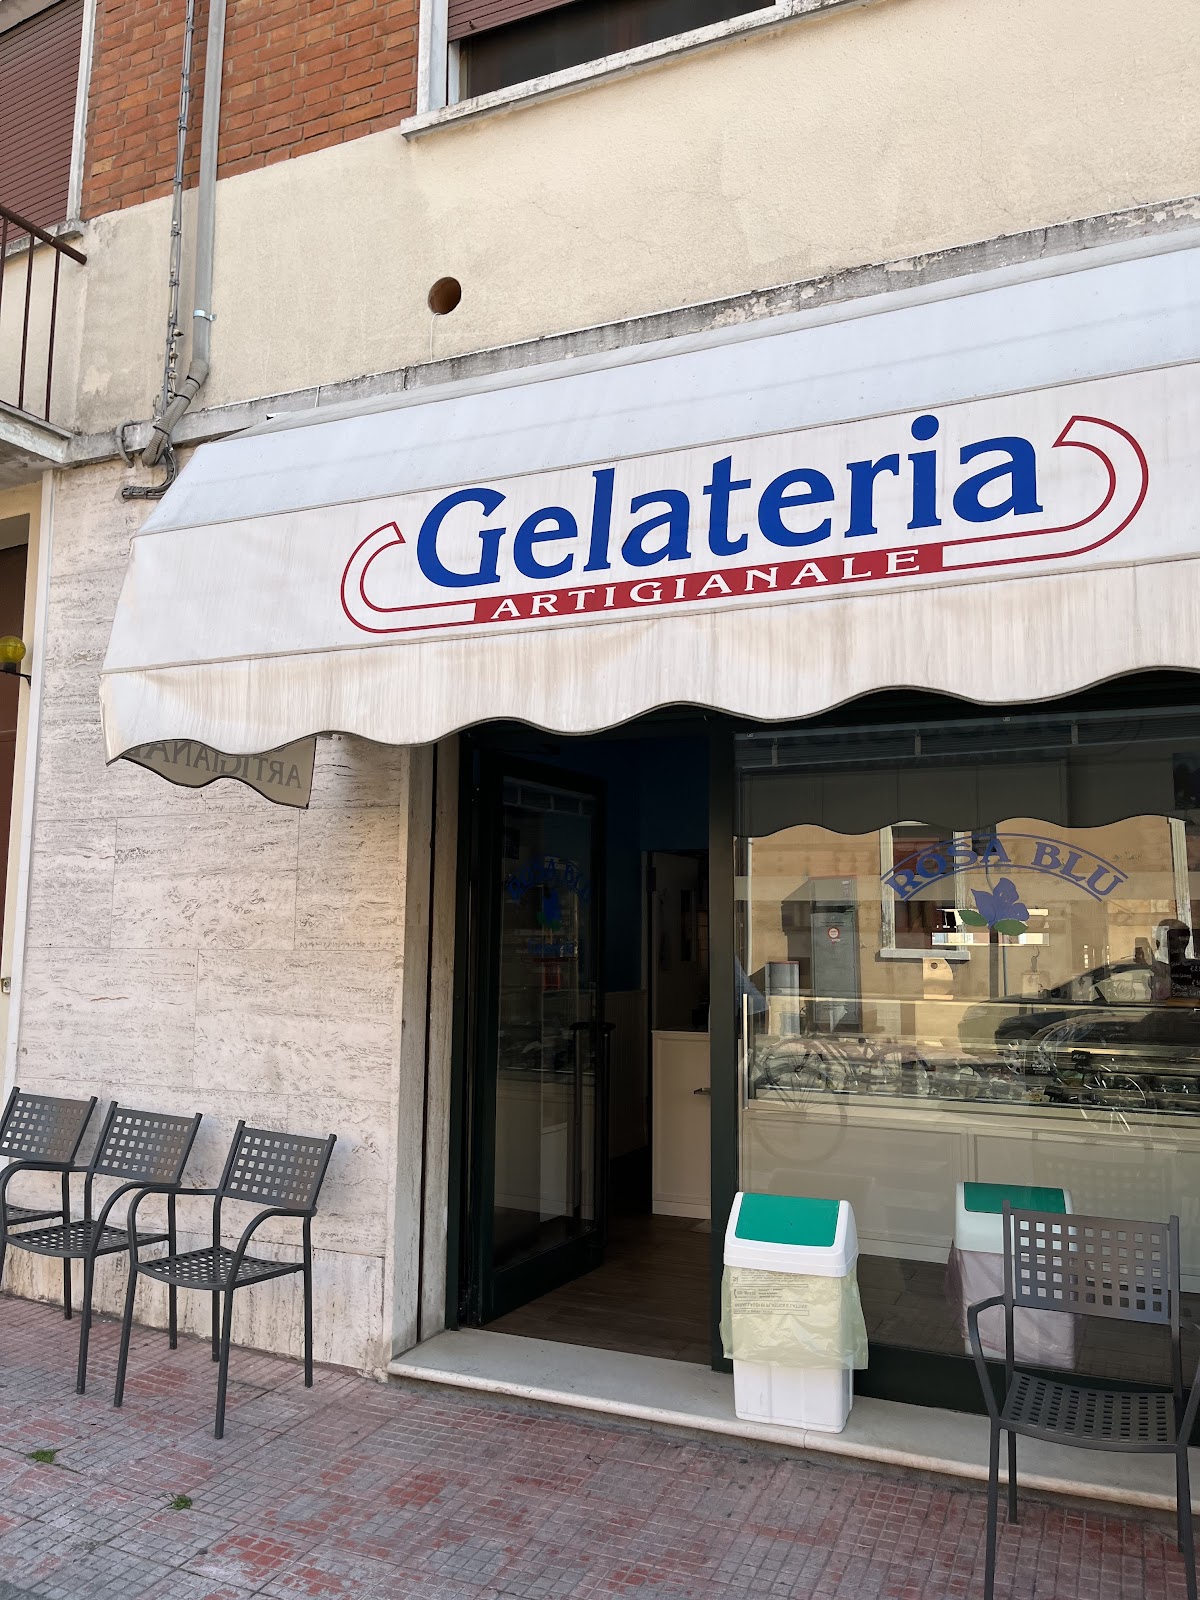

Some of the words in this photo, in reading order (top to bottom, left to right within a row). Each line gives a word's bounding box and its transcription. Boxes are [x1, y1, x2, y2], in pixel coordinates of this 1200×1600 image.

[417, 414, 1043, 588] Gelateria
[490, 547, 924, 622] ARTIGIANALE
[884, 838, 1012, 898] ROSA
[1031, 841, 1124, 896] BLU
